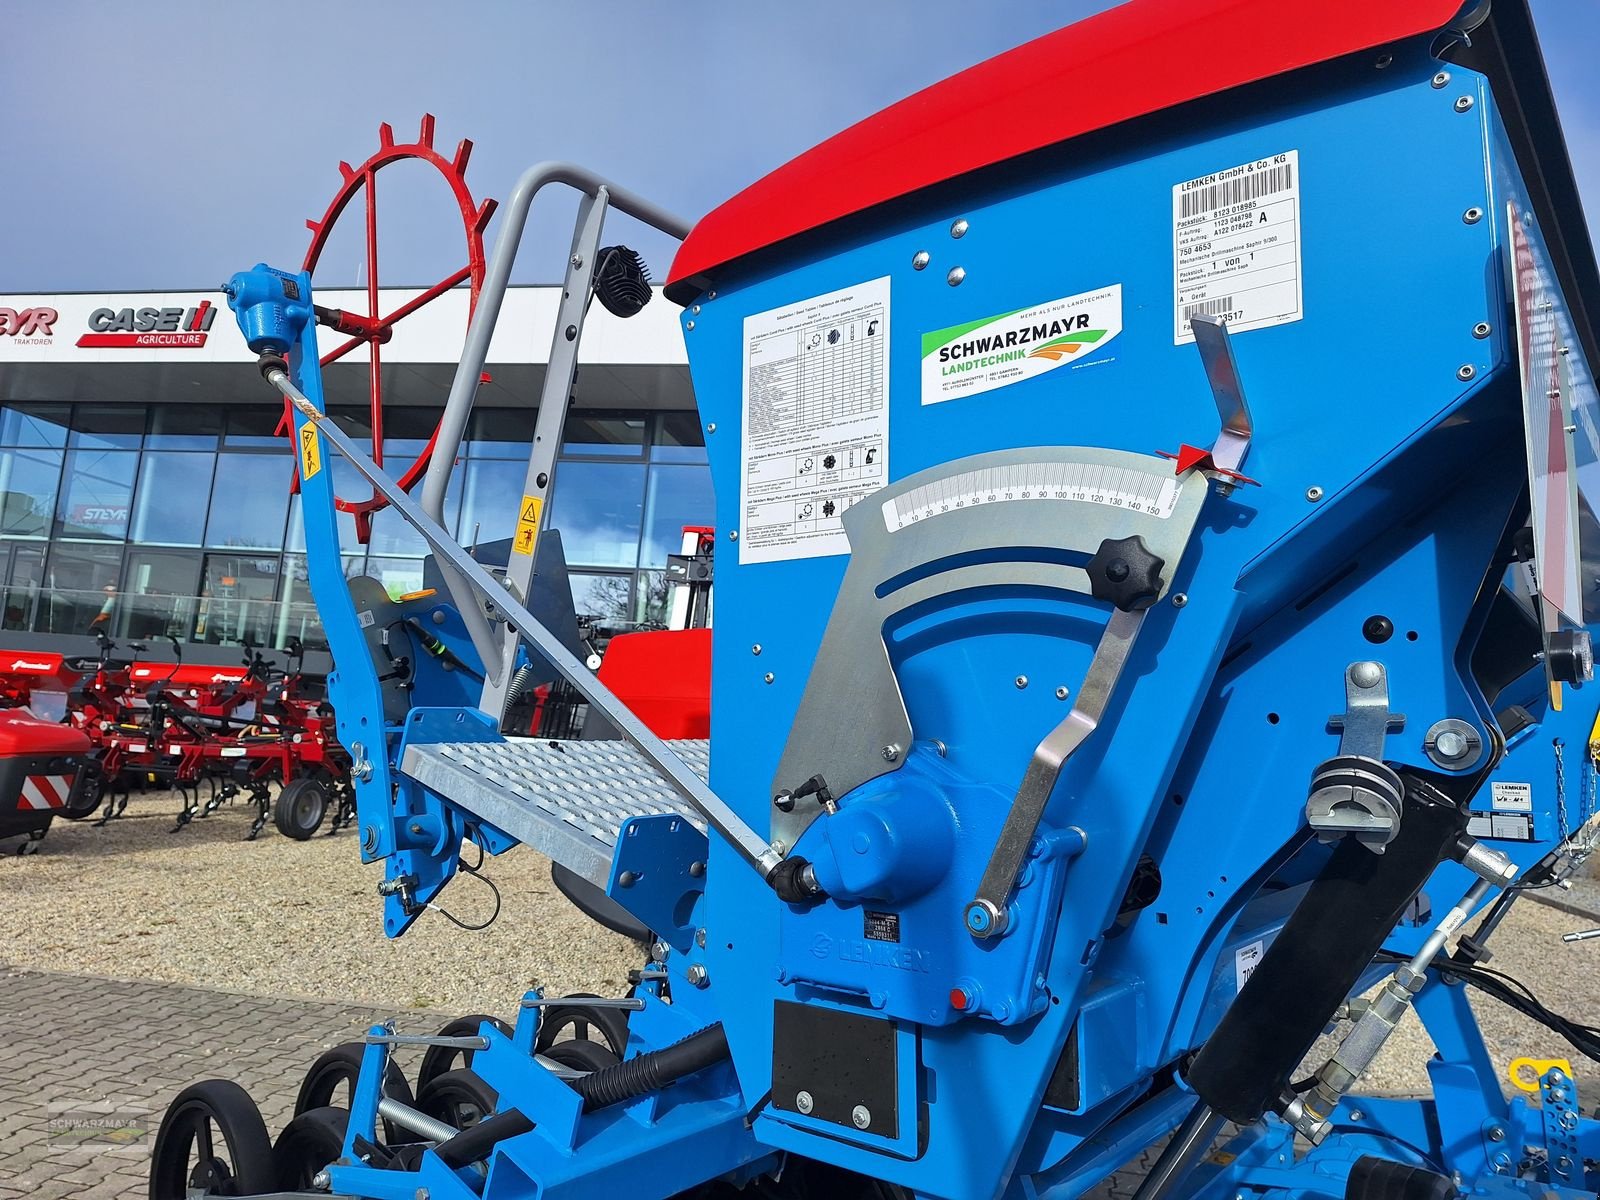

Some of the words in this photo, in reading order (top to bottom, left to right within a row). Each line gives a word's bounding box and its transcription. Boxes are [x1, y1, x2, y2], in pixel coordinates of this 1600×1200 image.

[1181, 174, 1215, 191] LEMKEN
[1218, 166, 1244, 181] GmbH
[1247, 163, 1254, 172] &
[1256, 160, 1271, 170] Co.
[1273, 154, 1286, 164] KG
[1213, 208, 1230, 218] 8123
[1231, 201, 1257, 215] 018985
[1214, 217, 1229, 227] 1123
[1259, 211, 1267, 223] A
[1213, 225, 1229, 236] A122
[1179, 247, 1192, 257] 750
[1194, 242, 1212, 253] 4653
[1211, 245, 1245, 257] Drillmaschine
[1212, 262, 1216, 270] 1
[1224, 257, 1240, 267] von
[1249, 252, 1254, 260] 1
[1191, 291, 1207, 300] Gerät
[88, 307, 184, 333] CASE
[1020, 311, 1037, 320] MEHR
[1052, 304, 1066, 312] NUR
[14, 338, 53, 346] TRAKTOREN
[136, 334, 201, 345] AGRICULTURE
[939, 313, 1090, 363] SCHWARZMAYR
[941, 348, 1026, 377] LANDTECHNIK
[83, 508, 128, 520] STEYR
[911, 514, 919, 522] 10
[925, 509, 934, 517] 20
[940, 504, 949, 512] 30
[955, 500, 964, 508] 40
[971, 497, 980, 505] 50
[987, 494, 996, 502] 60
[1004, 492, 1013, 500] 70
[1021, 491, 1031, 499] 80
[1038, 490, 1048, 498] 90
[1054, 491, 1067, 499] 100
[1071, 492, 1085, 500] 110
[1090, 494, 1104, 503] 120
[1108, 496, 1123, 506] 130
[1127, 500, 1141, 511] 140
[1145, 505, 1161, 516] 150
